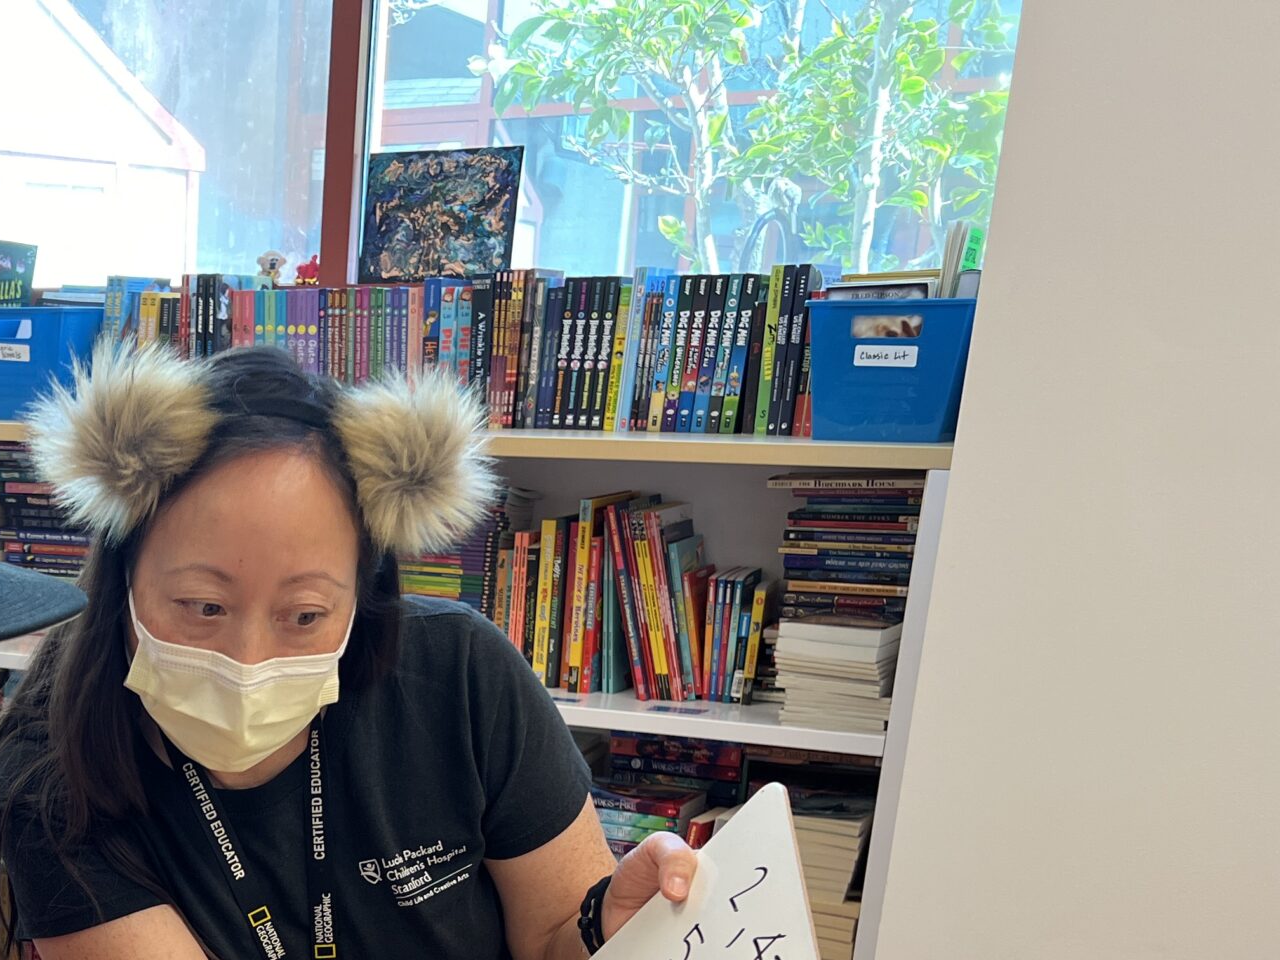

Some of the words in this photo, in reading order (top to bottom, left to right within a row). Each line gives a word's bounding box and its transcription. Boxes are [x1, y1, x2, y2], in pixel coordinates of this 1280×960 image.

[798, 275, 806, 296] TAKEI
[478, 312, 486, 320] A
[663, 311, 675, 328] DOG
[678, 310, 690, 328] DOG
[693, 310, 705, 328] DOG
[708, 310, 721, 328] DOG
[724, 311, 737, 328] DOG
[739, 310, 752, 328] DOG
[476, 321, 486, 356] Wrinkle
[660, 330, 671, 346] MAN
[676, 329, 687, 346] MAN
[691, 329, 702, 346] MAN
[706, 329, 718, 346] MAN
[721, 330, 733, 347] MAN
[736, 329, 747, 346] MAN
[790, 324, 798, 344] ENEMY
[297, 339, 306, 364] Guts
[307, 339, 317, 364] Guts
[860, 352, 889, 360] Classic
[894, 352, 910, 360] Lit
[476, 359, 483, 367] in
[672, 346, 684, 387] UNLEASHED
[866, 479, 896, 488] HOUSE
[576, 577, 584, 592] BOOK
[572, 605, 582, 642] Heroines
[310, 730, 323, 795] EDUCATOR
[651, 759, 673, 771] WINGS
[679, 763, 697, 774] FIRE
[619, 800, 637, 811] FIRE
[182, 762, 217, 821] CERTIFIED
[210, 819, 246, 881] EDUCATOR
[310, 797, 326, 860] CERTIFIED
[402, 840, 444, 861] Packard
[426, 845, 467, 866] Hospital
[391, 871, 433, 895] Stanford
[397, 899, 414, 907] Child
[423, 890, 434, 900] and
[433, 879, 458, 894] Creative
[457, 872, 470, 883] Arts
[314, 904, 322, 943] NATIONAL
[321, 892, 334, 944] GEOGRAPHIC
[263, 921, 286, 959] NATIONAL
